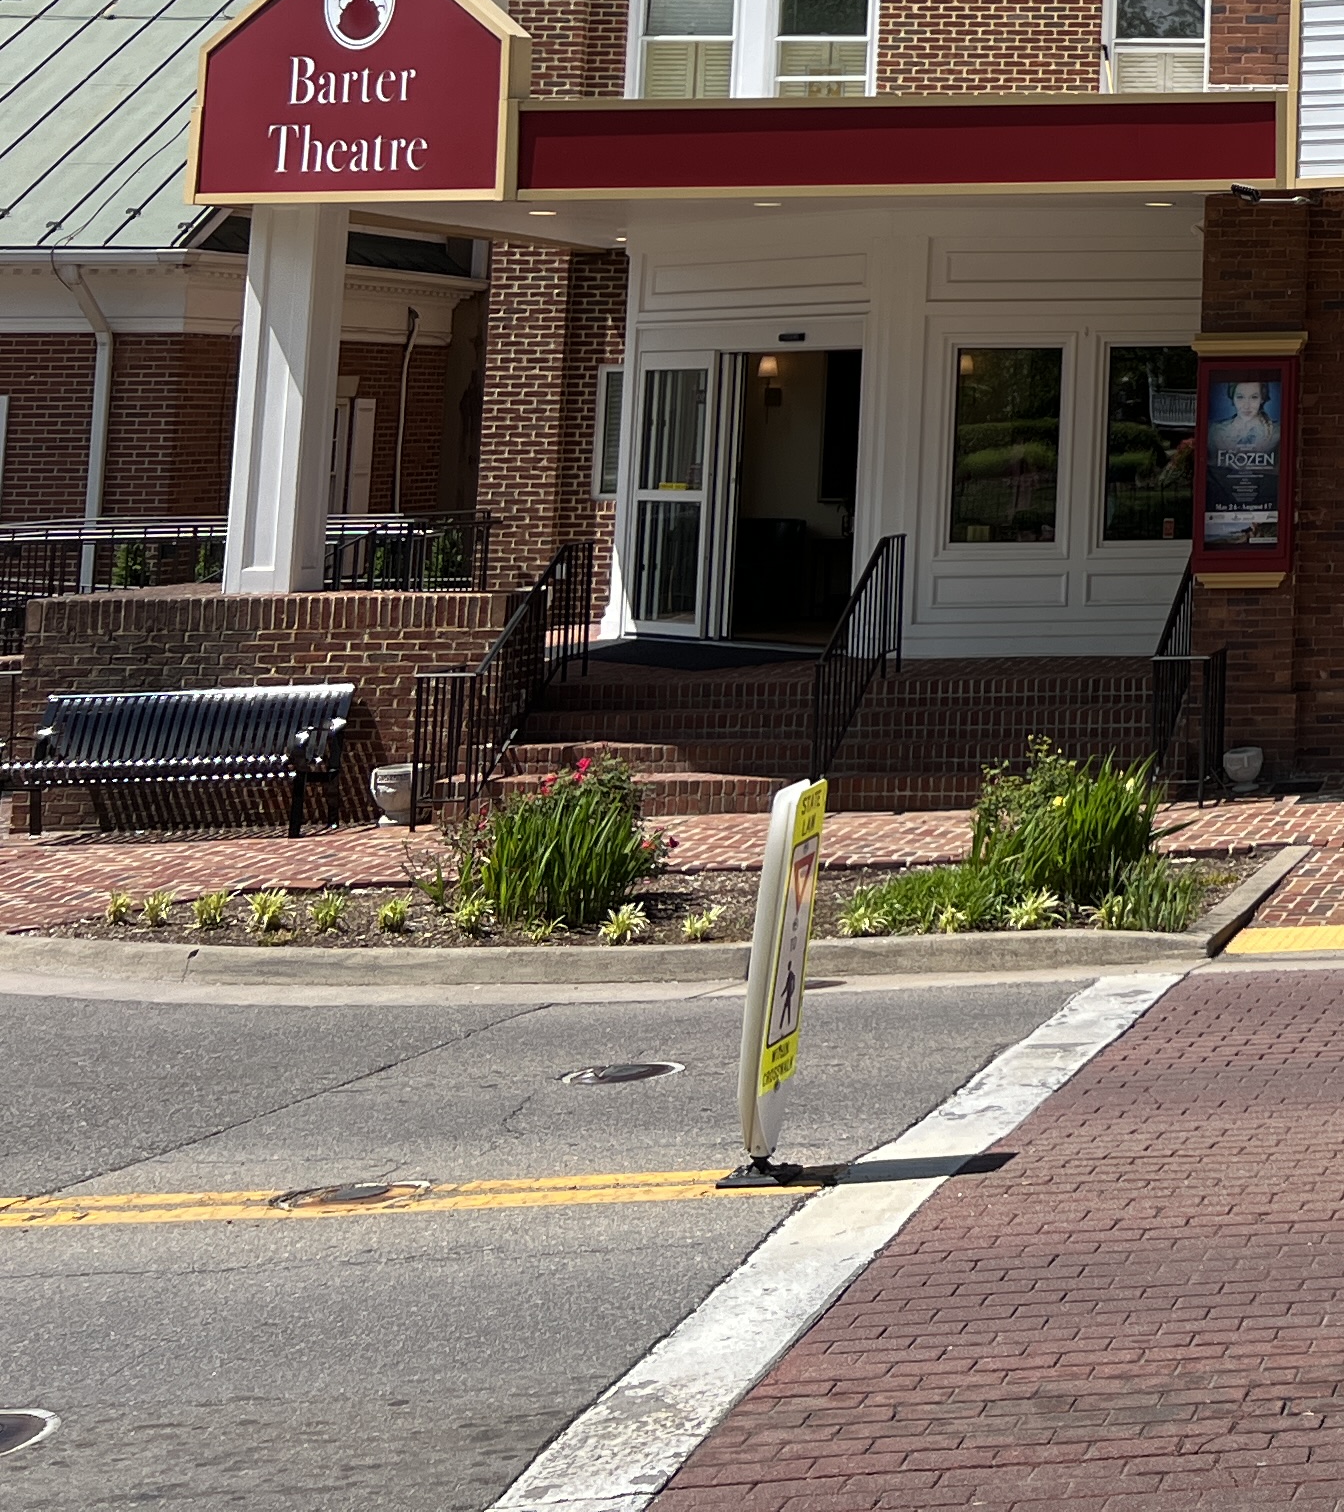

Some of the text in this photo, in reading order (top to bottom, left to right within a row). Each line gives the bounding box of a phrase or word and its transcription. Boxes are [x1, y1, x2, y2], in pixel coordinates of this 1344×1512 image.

[287, 55, 417, 105] Barter
[267, 123, 429, 174] Theatre
[1217, 449, 1275, 469] FROZEN
[801, 789, 822, 816] STATE
[801, 813, 817, 837] LAW
